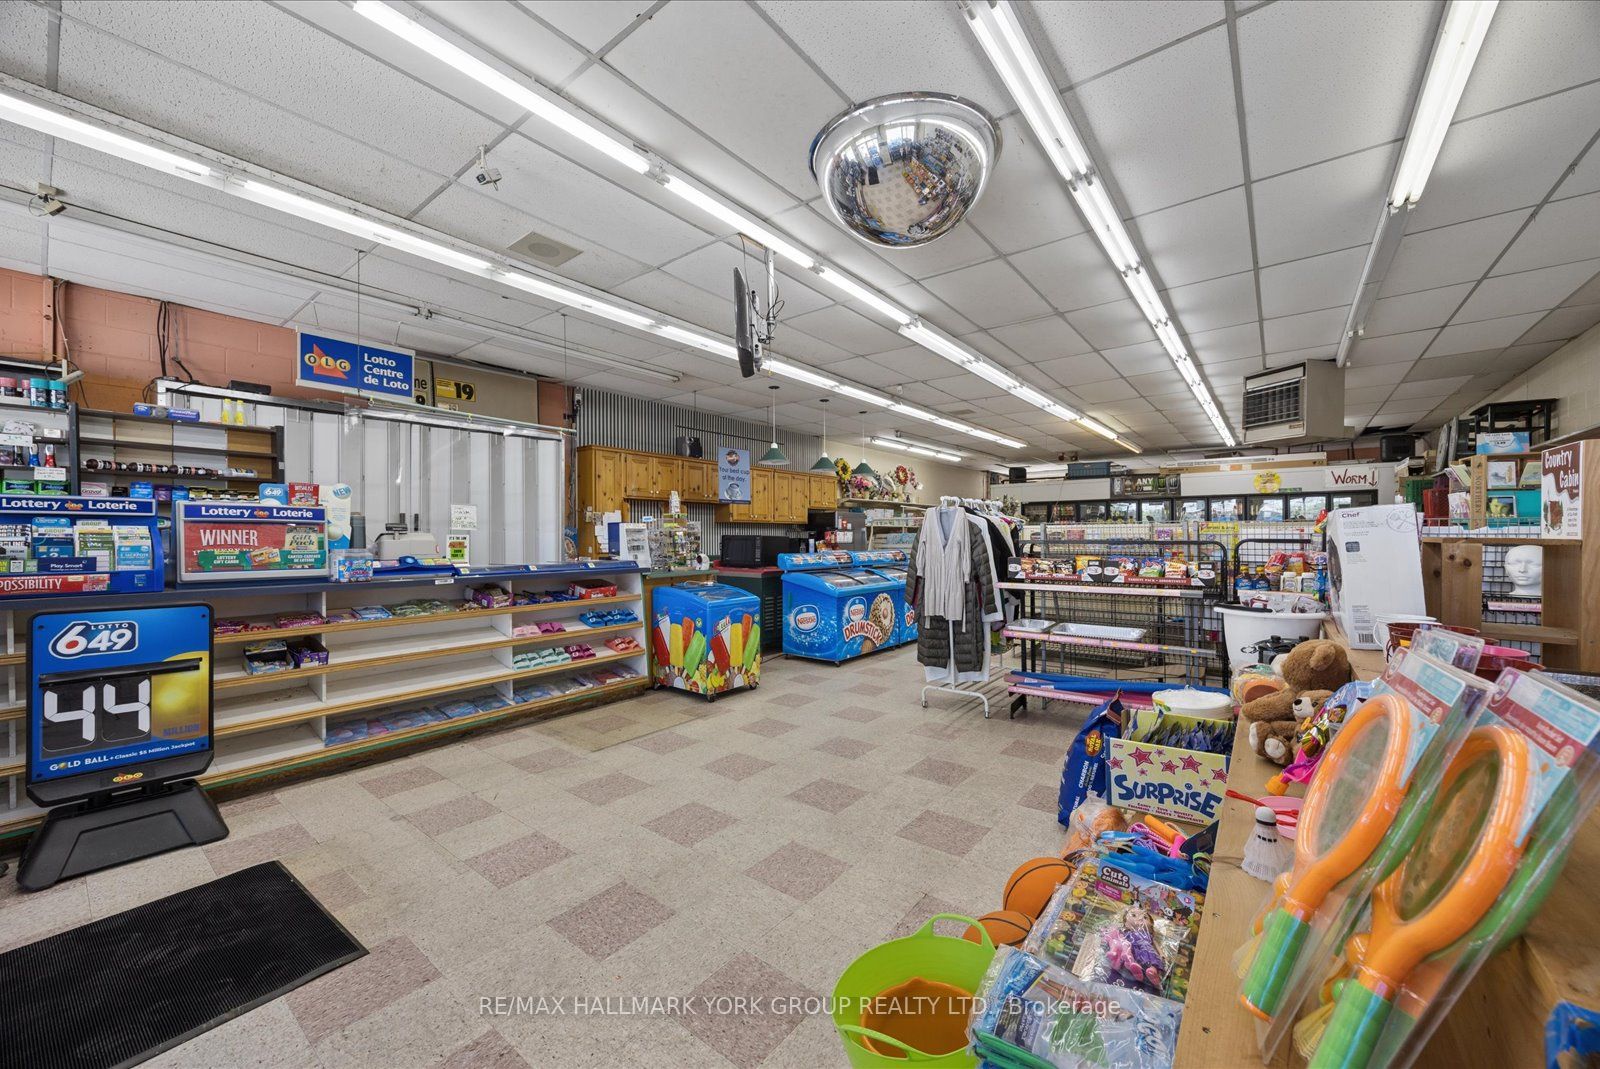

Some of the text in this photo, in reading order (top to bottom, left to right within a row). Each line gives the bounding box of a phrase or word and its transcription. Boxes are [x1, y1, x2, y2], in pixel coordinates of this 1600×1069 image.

[305, 354, 350, 371] OLG
[364, 352, 396, 367] Lotto
[364, 365, 404, 379] Centre
[364, 376, 410, 390] de Loto
[454, 382, 474, 400] 19
[1545, 450, 1572, 468] Country
[1560, 469, 1579, 488] Cabin
[333, 486, 351, 497] NEW
[2, 498, 62, 510] Lottery
[88, 500, 138, 510] Loterie
[201, 506, 251, 518] Lottery
[273, 508, 313, 518] Loterie
[200, 530, 258, 546] WINNER
[844, 622, 882, 643] DRUMSTICK
[163, 724, 200, 736] MILLION
[50, 760, 81, 771] GOLD
[85, 755, 108, 765] BALL
[148, 745, 170, 754] Million
[170, 741, 196, 750] Jackpot
[1078, 760, 1089, 788] CHARBON
[1102, 867, 1128, 882] Cute
[1102, 874, 1129, 888] animals
